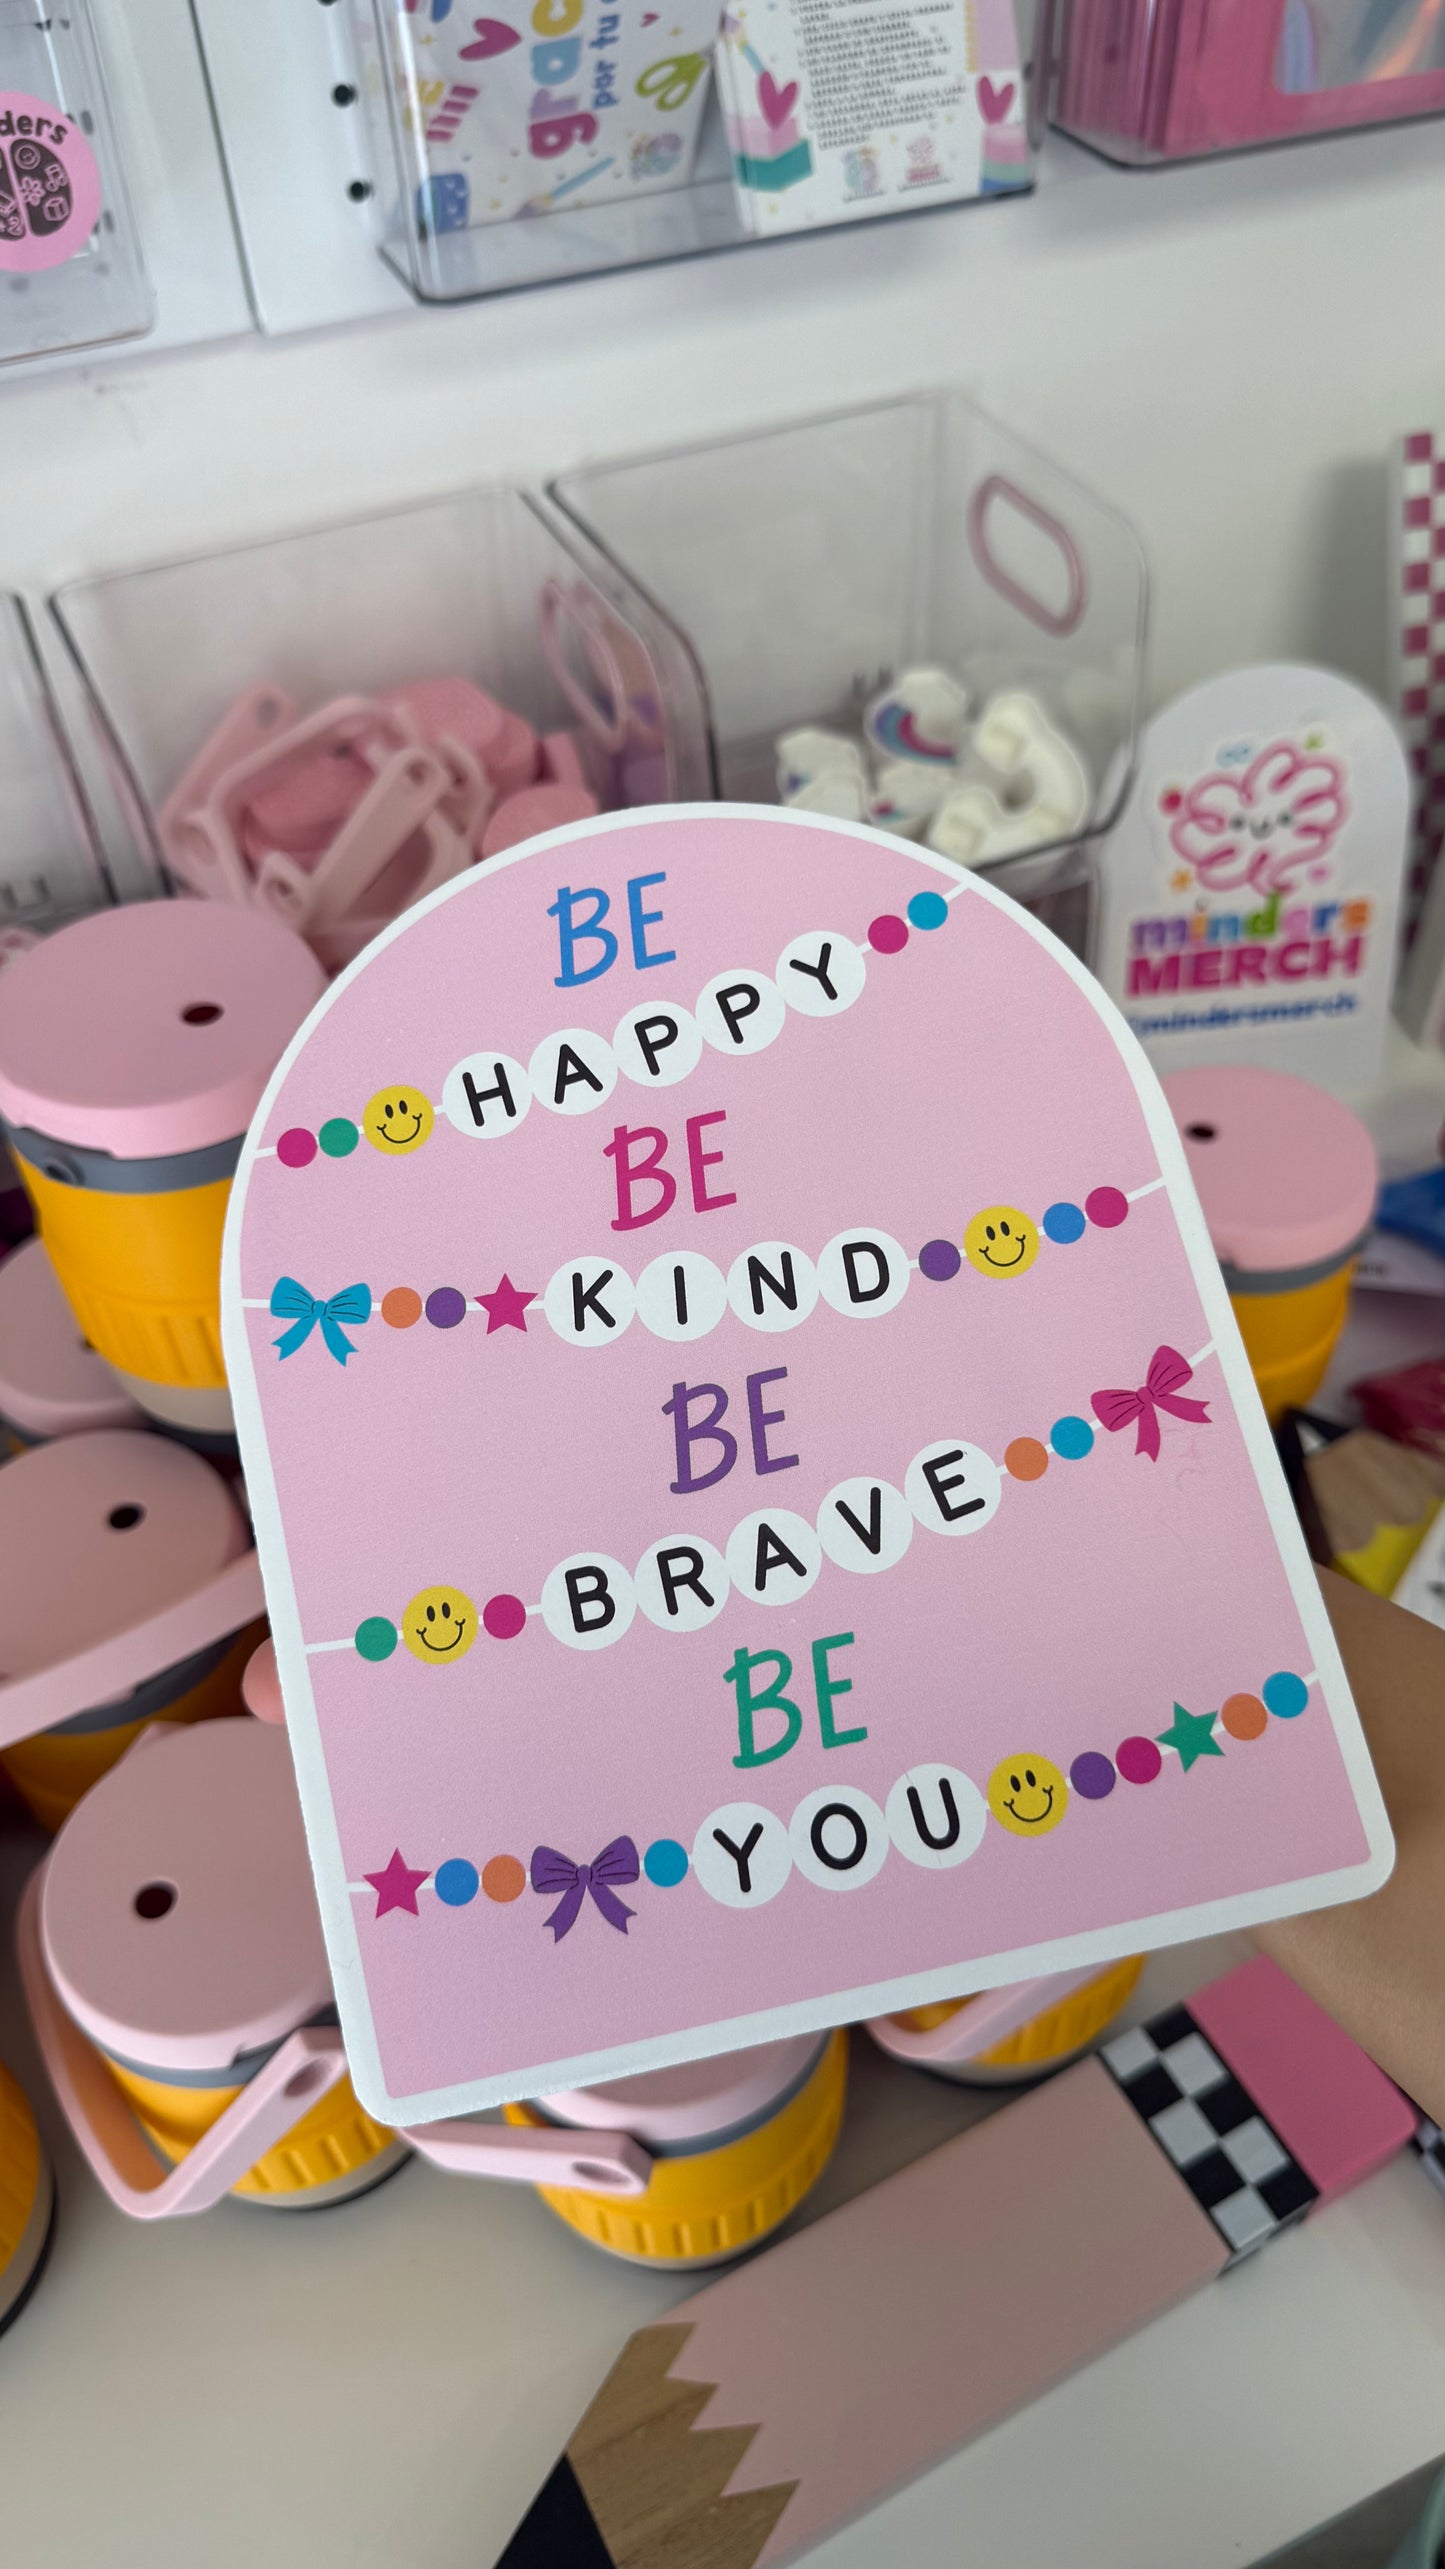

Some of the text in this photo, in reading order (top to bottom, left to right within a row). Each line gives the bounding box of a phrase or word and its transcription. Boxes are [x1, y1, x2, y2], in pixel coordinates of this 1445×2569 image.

[588, 13, 619, 109] por tu
[547, 872, 676, 988] BE
[1127, 934, 1364, 998] MERCH
[1131, 890, 1370, 949] minders
[462, 942, 838, 1127] HAPPY
[602, 1110, 737, 1232] BE
[572, 1241, 890, 1332] KIND
[661, 1366, 800, 1494] BE
[564, 1449, 986, 1633] BRAVE
[723, 1632, 867, 1769] BE
[712, 1777, 960, 1893] YOU
